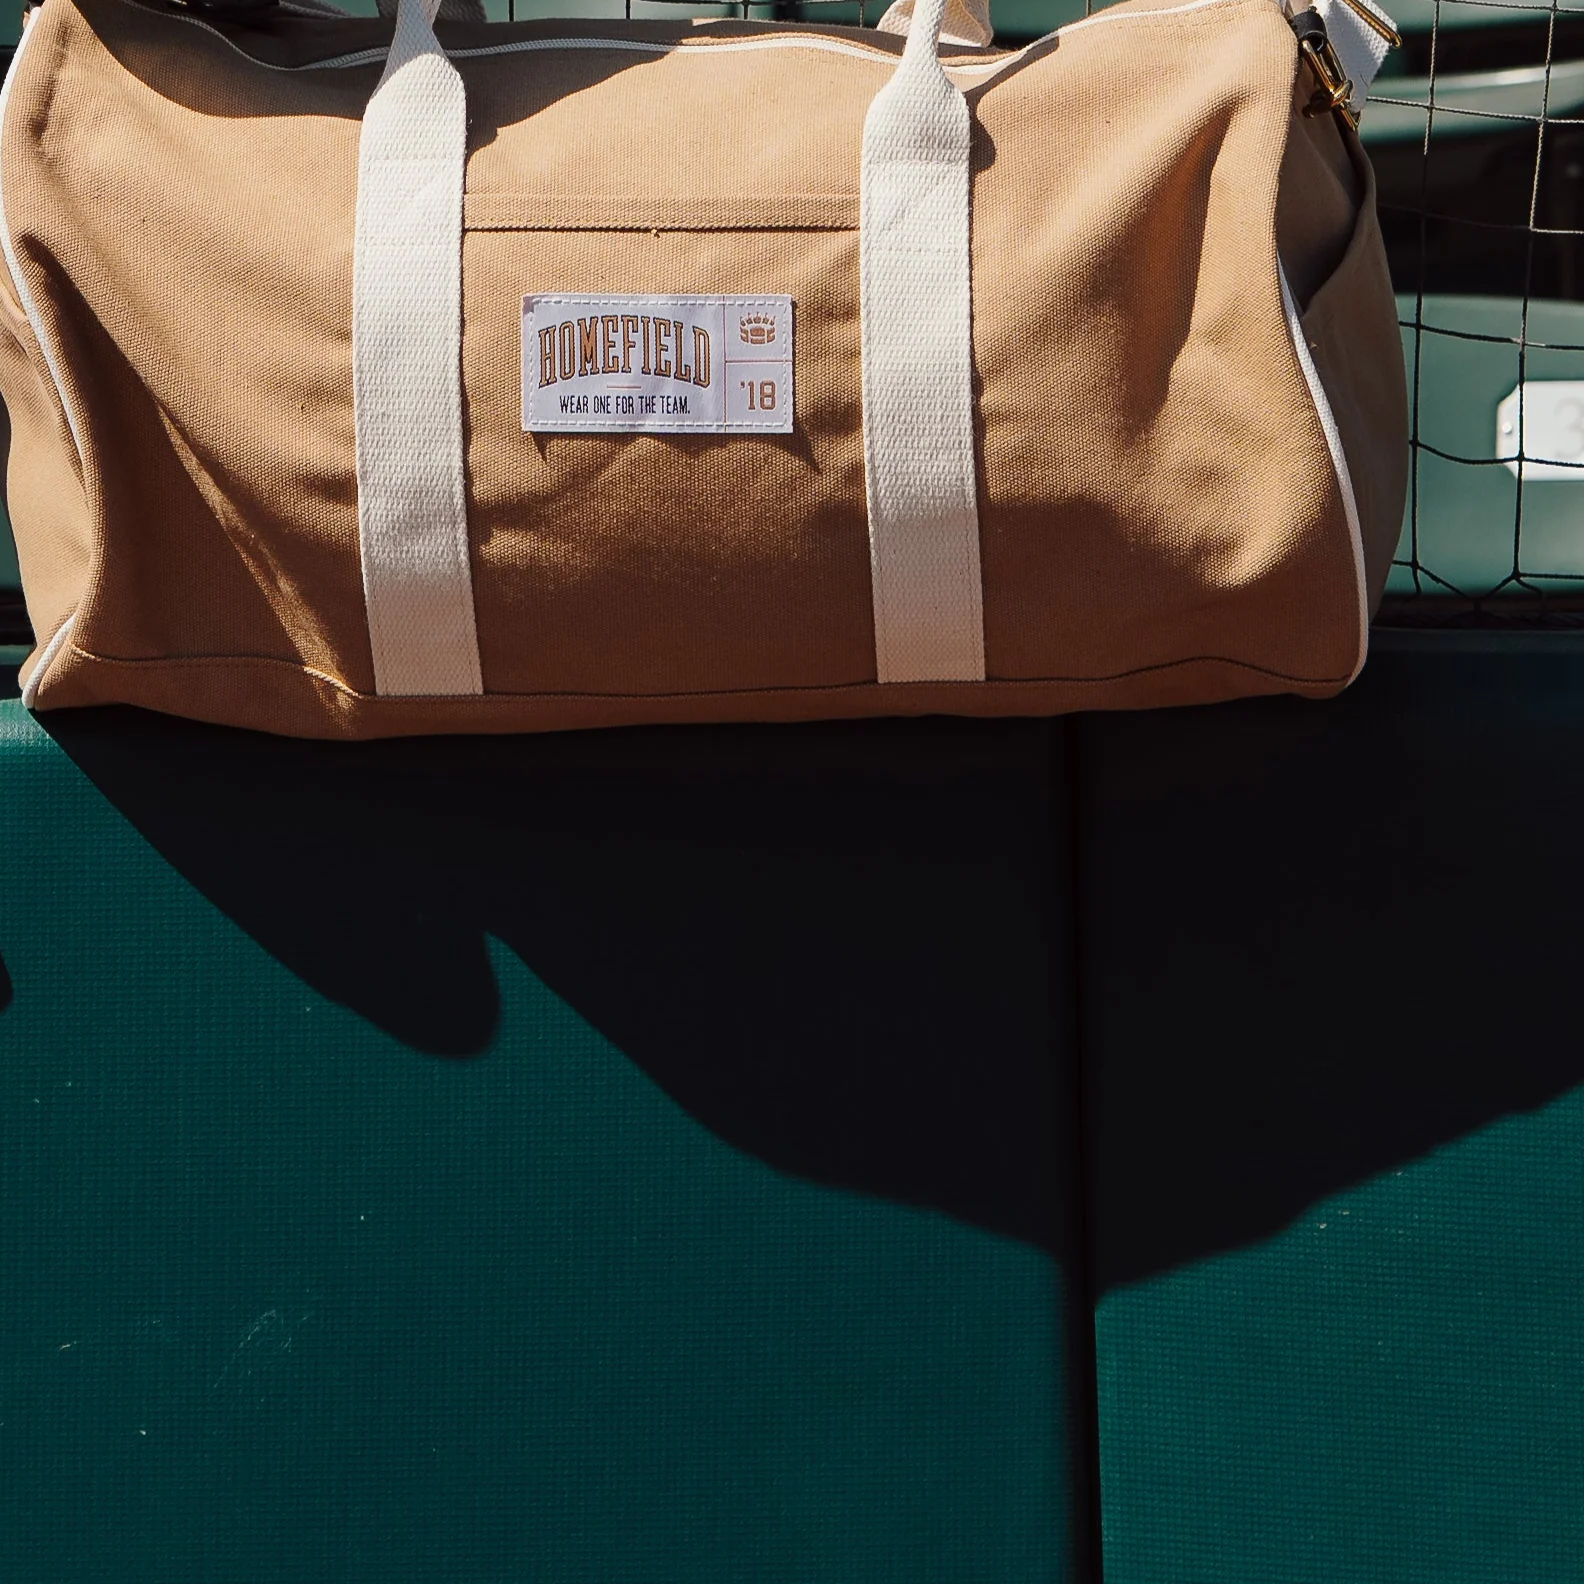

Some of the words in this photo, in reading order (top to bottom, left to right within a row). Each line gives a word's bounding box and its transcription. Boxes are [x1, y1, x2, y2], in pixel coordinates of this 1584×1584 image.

[538, 314, 711, 389] HOMEFIELD
[559, 395, 589, 414] WEAR
[593, 395, 612, 414] ONE
[616, 395, 635, 414] FOR
[638, 395, 657, 414] THE
[660, 395, 691, 414] TEAM.
